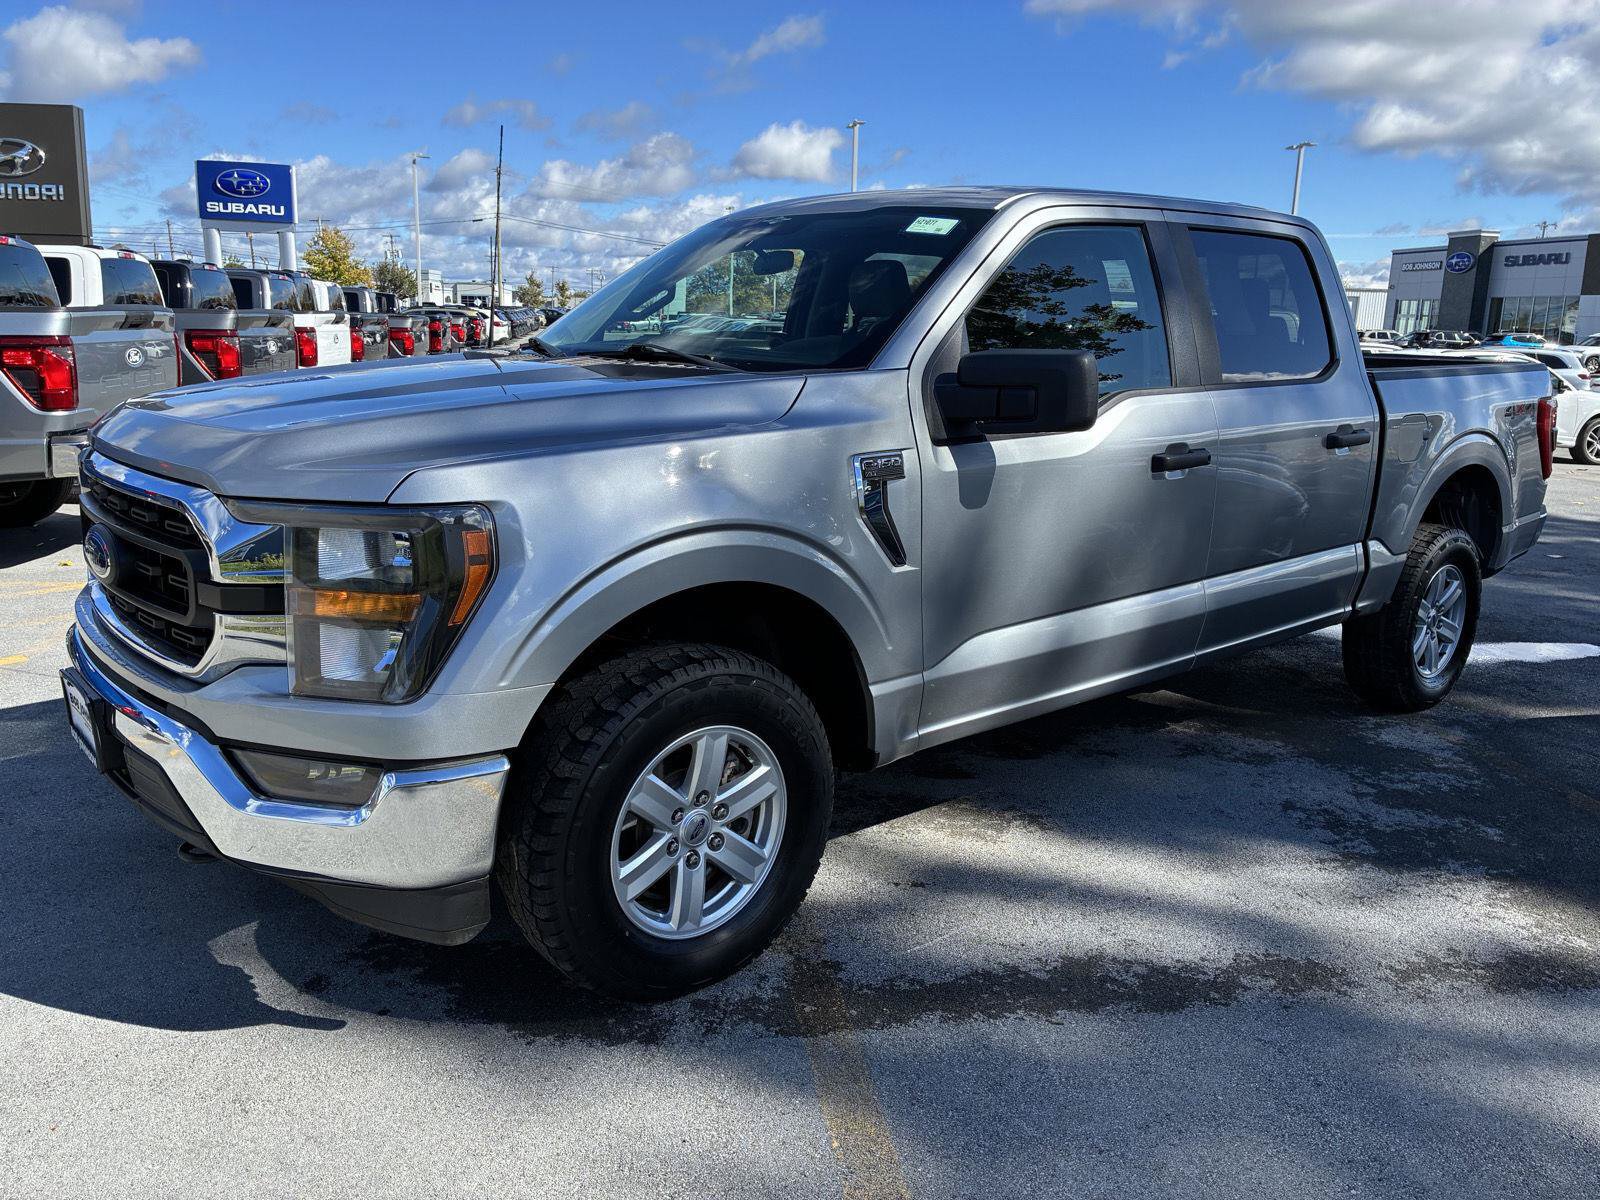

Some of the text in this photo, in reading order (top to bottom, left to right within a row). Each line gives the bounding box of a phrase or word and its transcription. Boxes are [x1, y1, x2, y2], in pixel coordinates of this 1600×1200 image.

[206, 201, 285, 216] SUBARU
[1401, 261, 1441, 271] BOB JOHNSON
[1503, 252, 1571, 267] SUBARU
